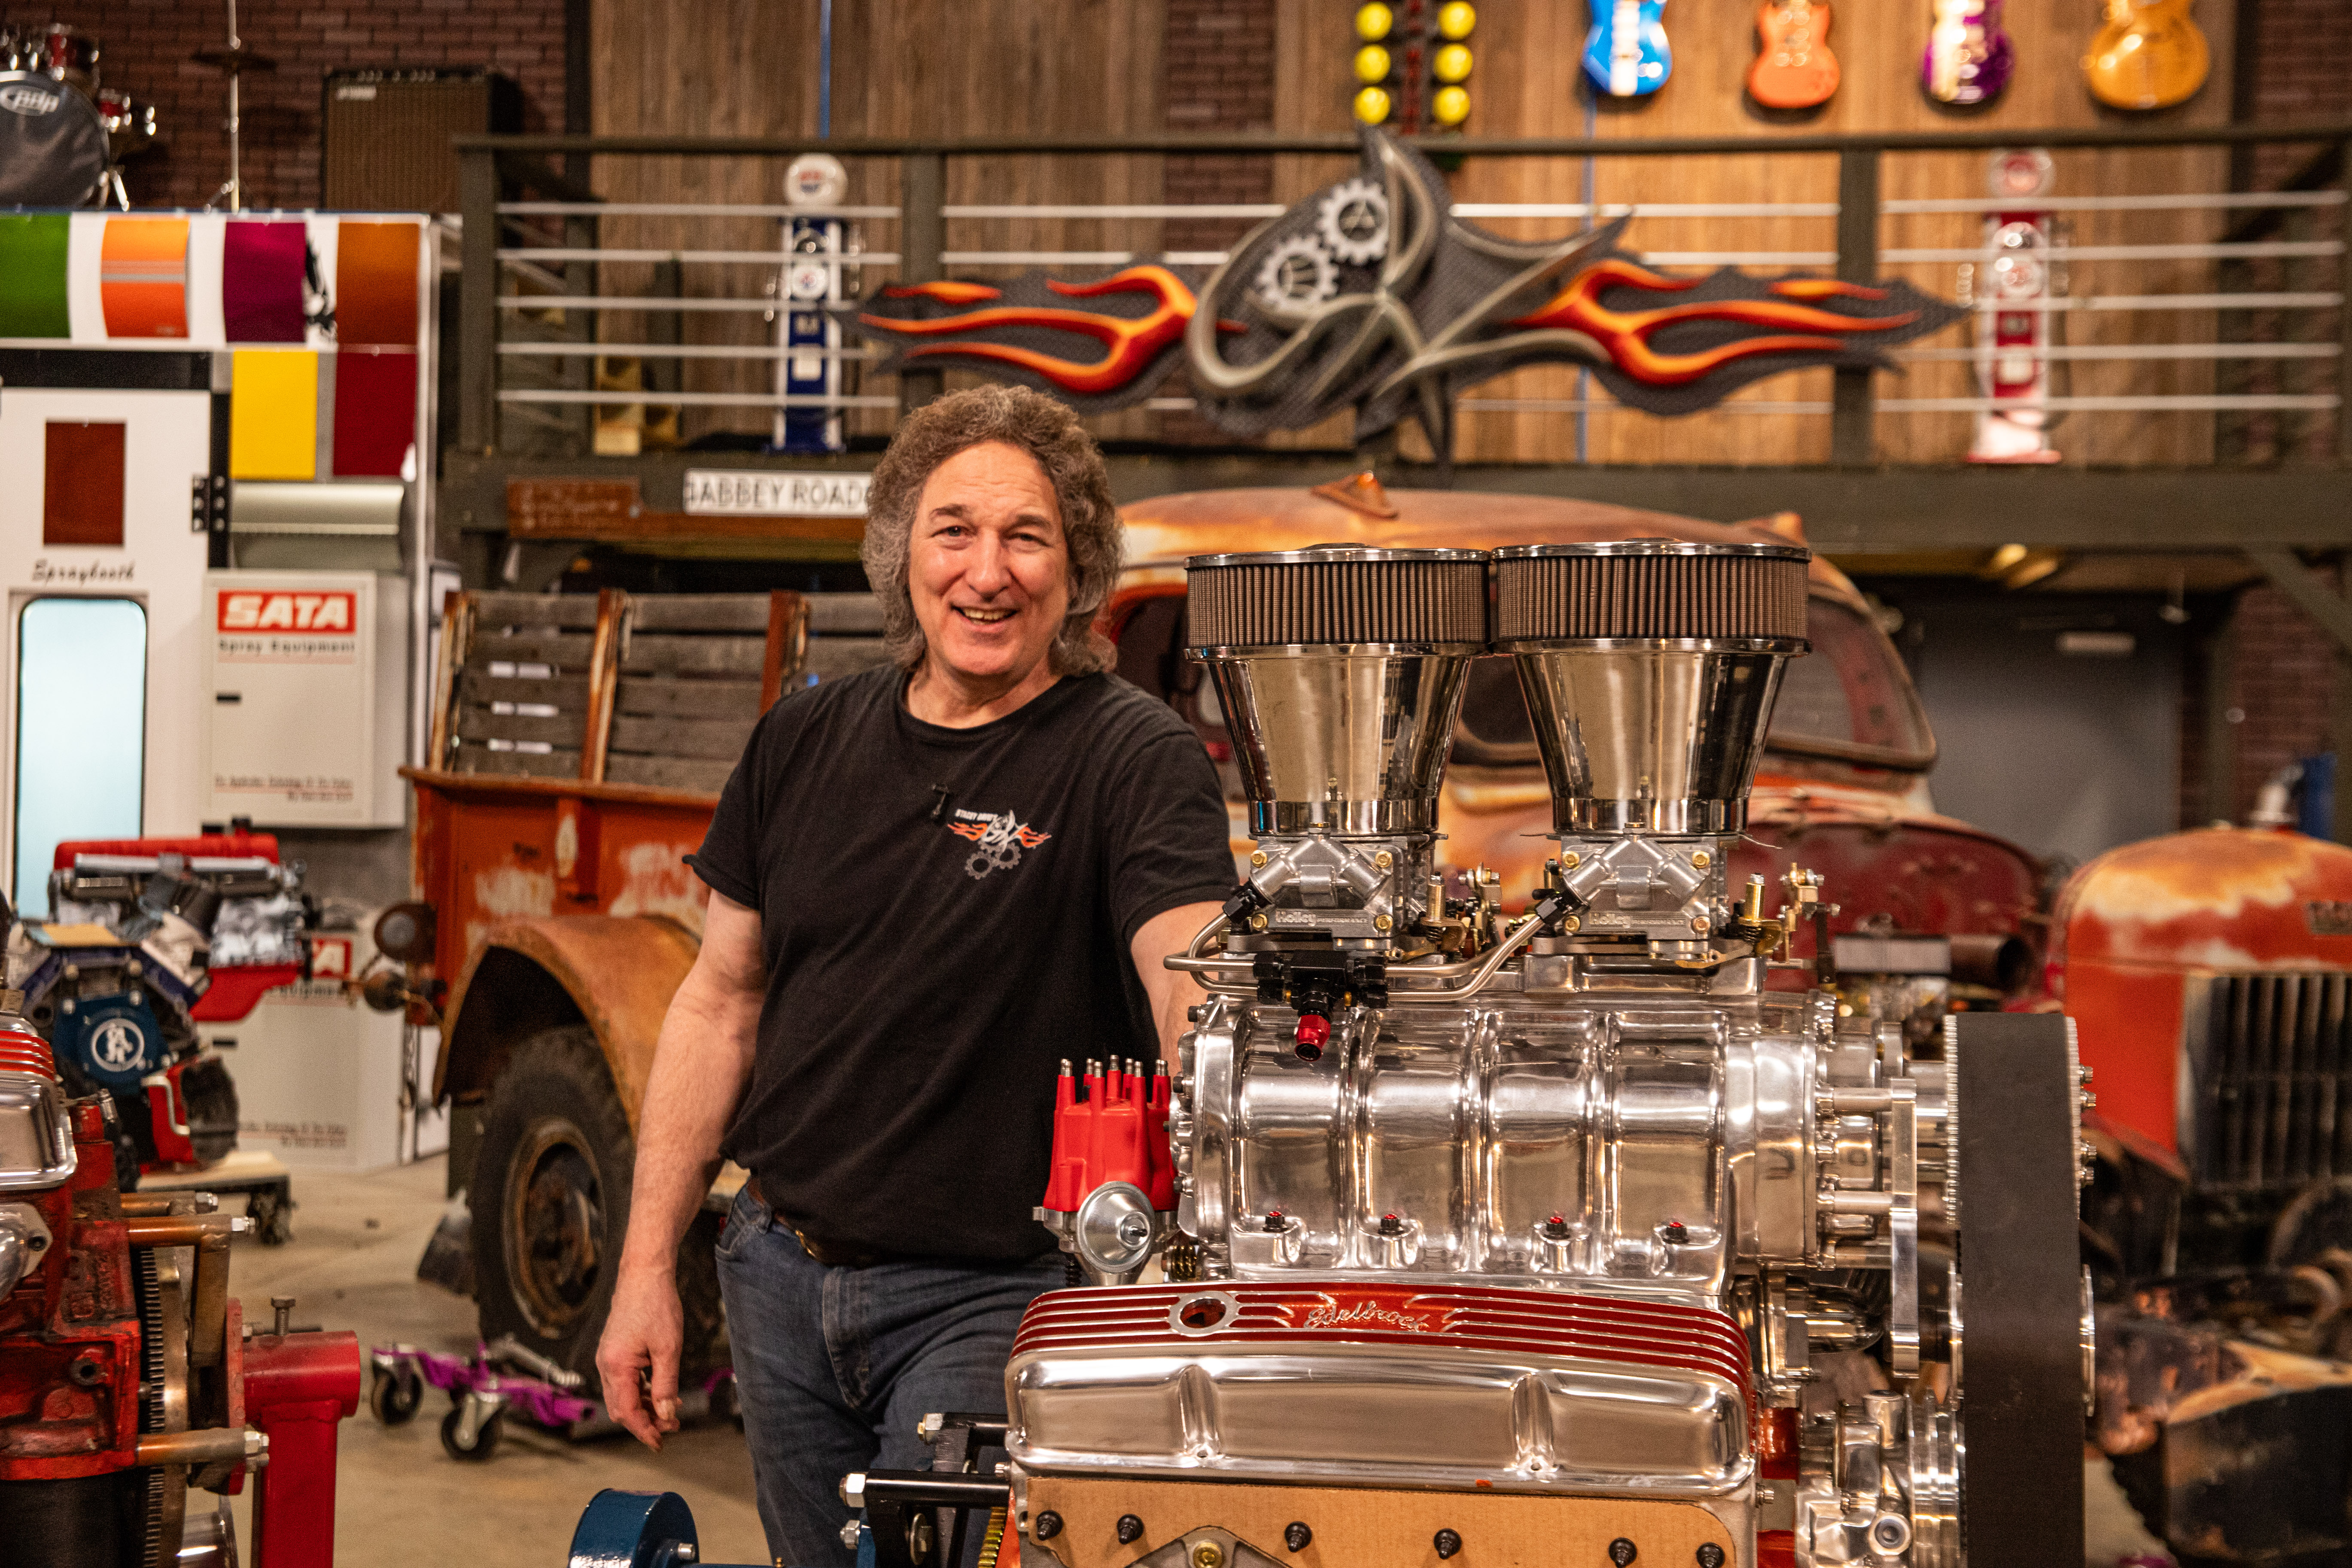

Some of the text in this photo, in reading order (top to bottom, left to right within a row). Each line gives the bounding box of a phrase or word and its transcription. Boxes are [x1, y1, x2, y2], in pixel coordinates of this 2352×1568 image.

[700, 478, 863, 508] ABBEY ROAD
[33, 558, 136, 587] Spraybooth
[224, 596, 349, 629] SATA
[219, 640, 356, 657] Spray Equipment
[1275, 910, 1316, 927] Holley
[1589, 913, 1631, 929] Holley
[1304, 1300, 1430, 1332] Edelbrock
